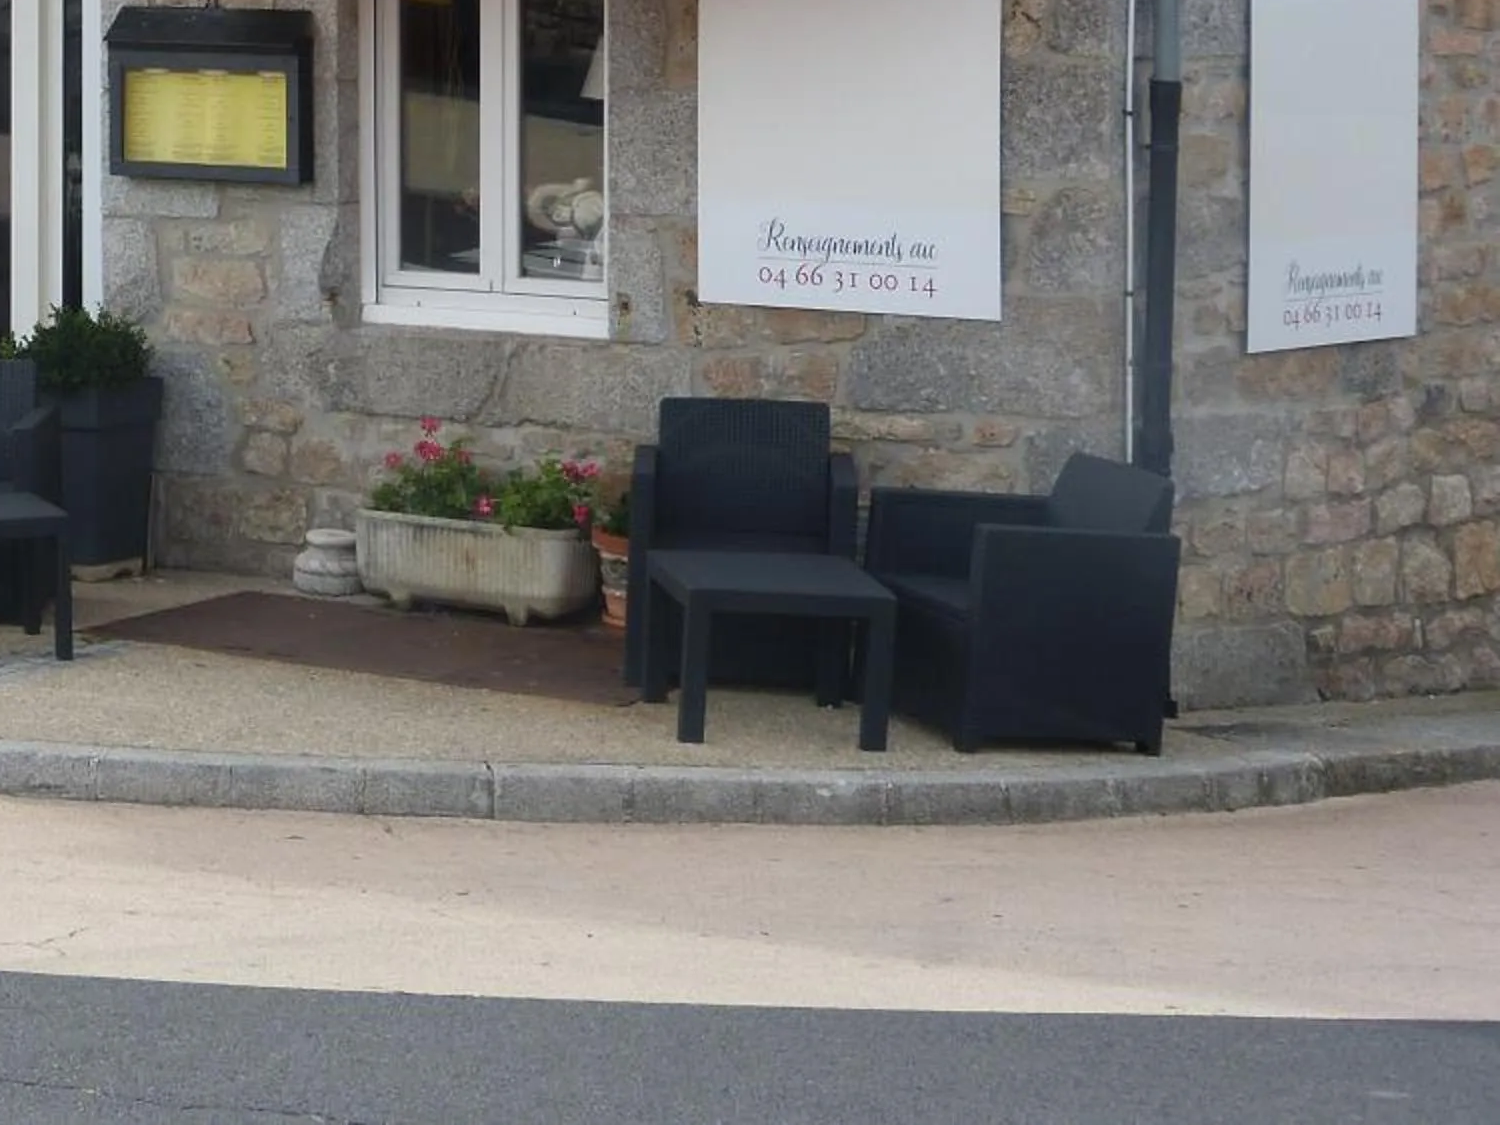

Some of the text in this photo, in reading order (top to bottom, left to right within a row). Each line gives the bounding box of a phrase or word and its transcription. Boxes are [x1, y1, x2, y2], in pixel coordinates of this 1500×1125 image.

[758, 261, 938, 299] 04 66 31 00 14
